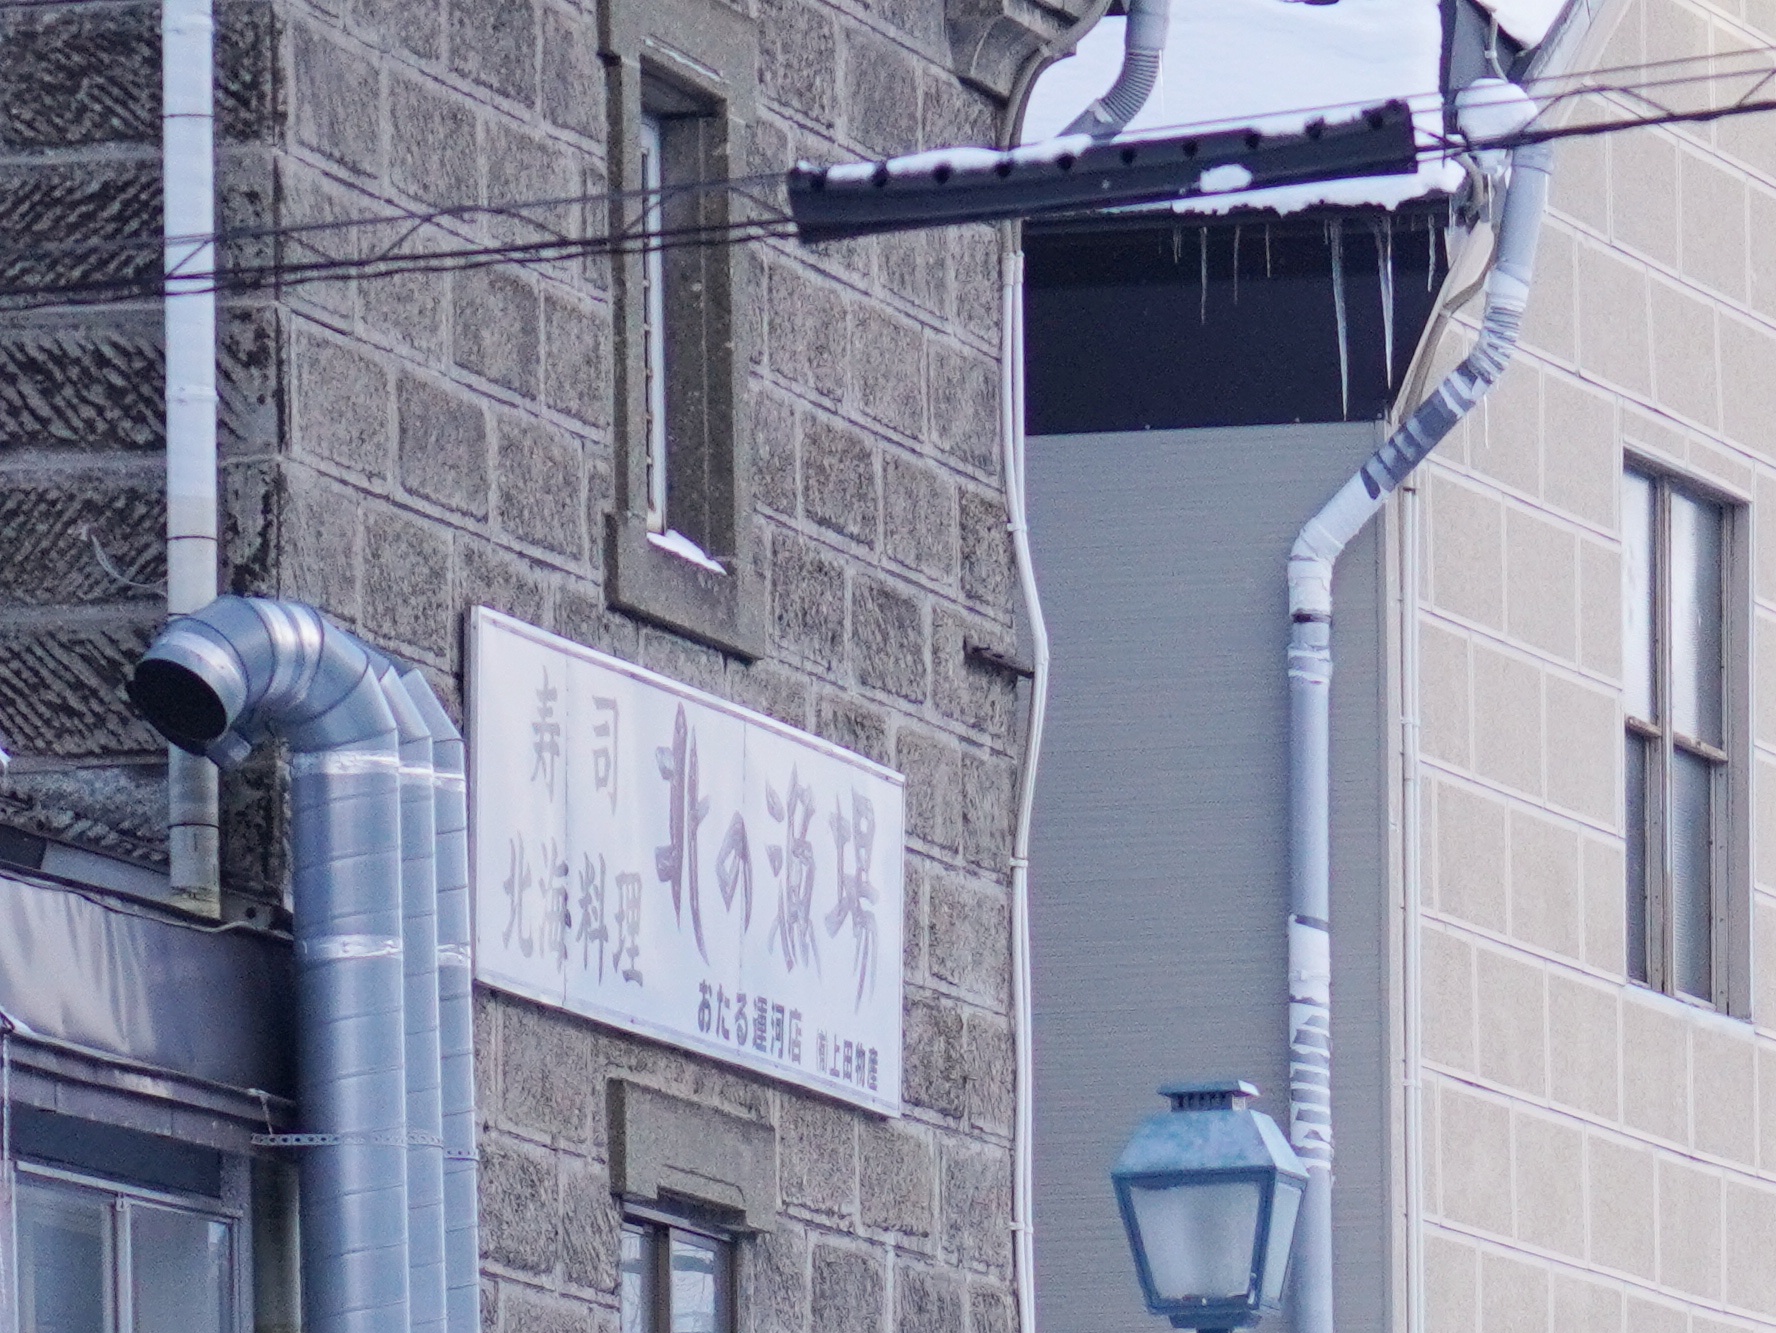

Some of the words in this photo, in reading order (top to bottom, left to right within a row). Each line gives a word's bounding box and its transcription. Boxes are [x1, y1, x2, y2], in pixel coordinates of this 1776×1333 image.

[529, 664, 620, 813] 寿司
[502, 831, 644, 987] 北海料理
[697, 978, 802, 1064] おたる運河店
